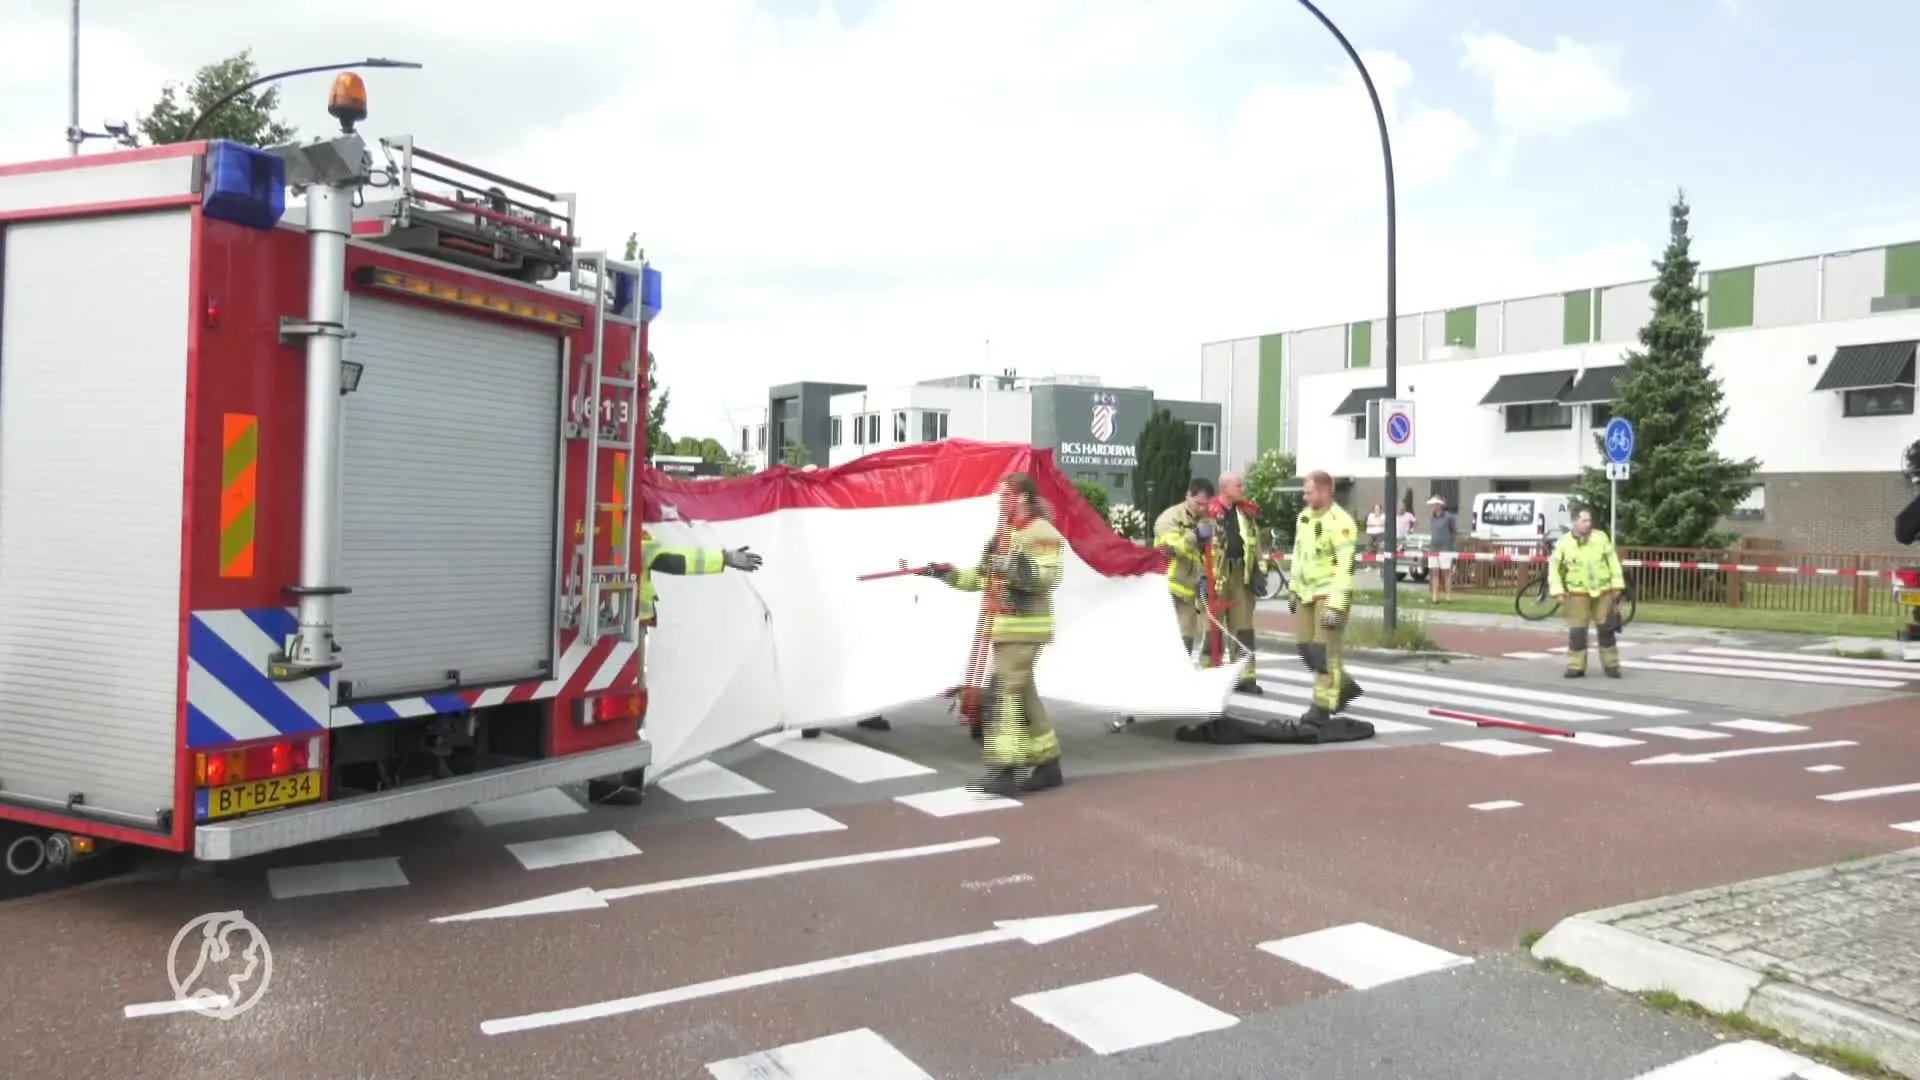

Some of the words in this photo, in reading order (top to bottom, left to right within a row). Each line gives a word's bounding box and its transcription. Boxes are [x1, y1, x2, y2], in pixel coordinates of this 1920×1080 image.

[1061, 442, 1081, 454] BCS
[1484, 502, 1532, 514] AMEX
[219, 775, 312, 811] BT-BZ-34
